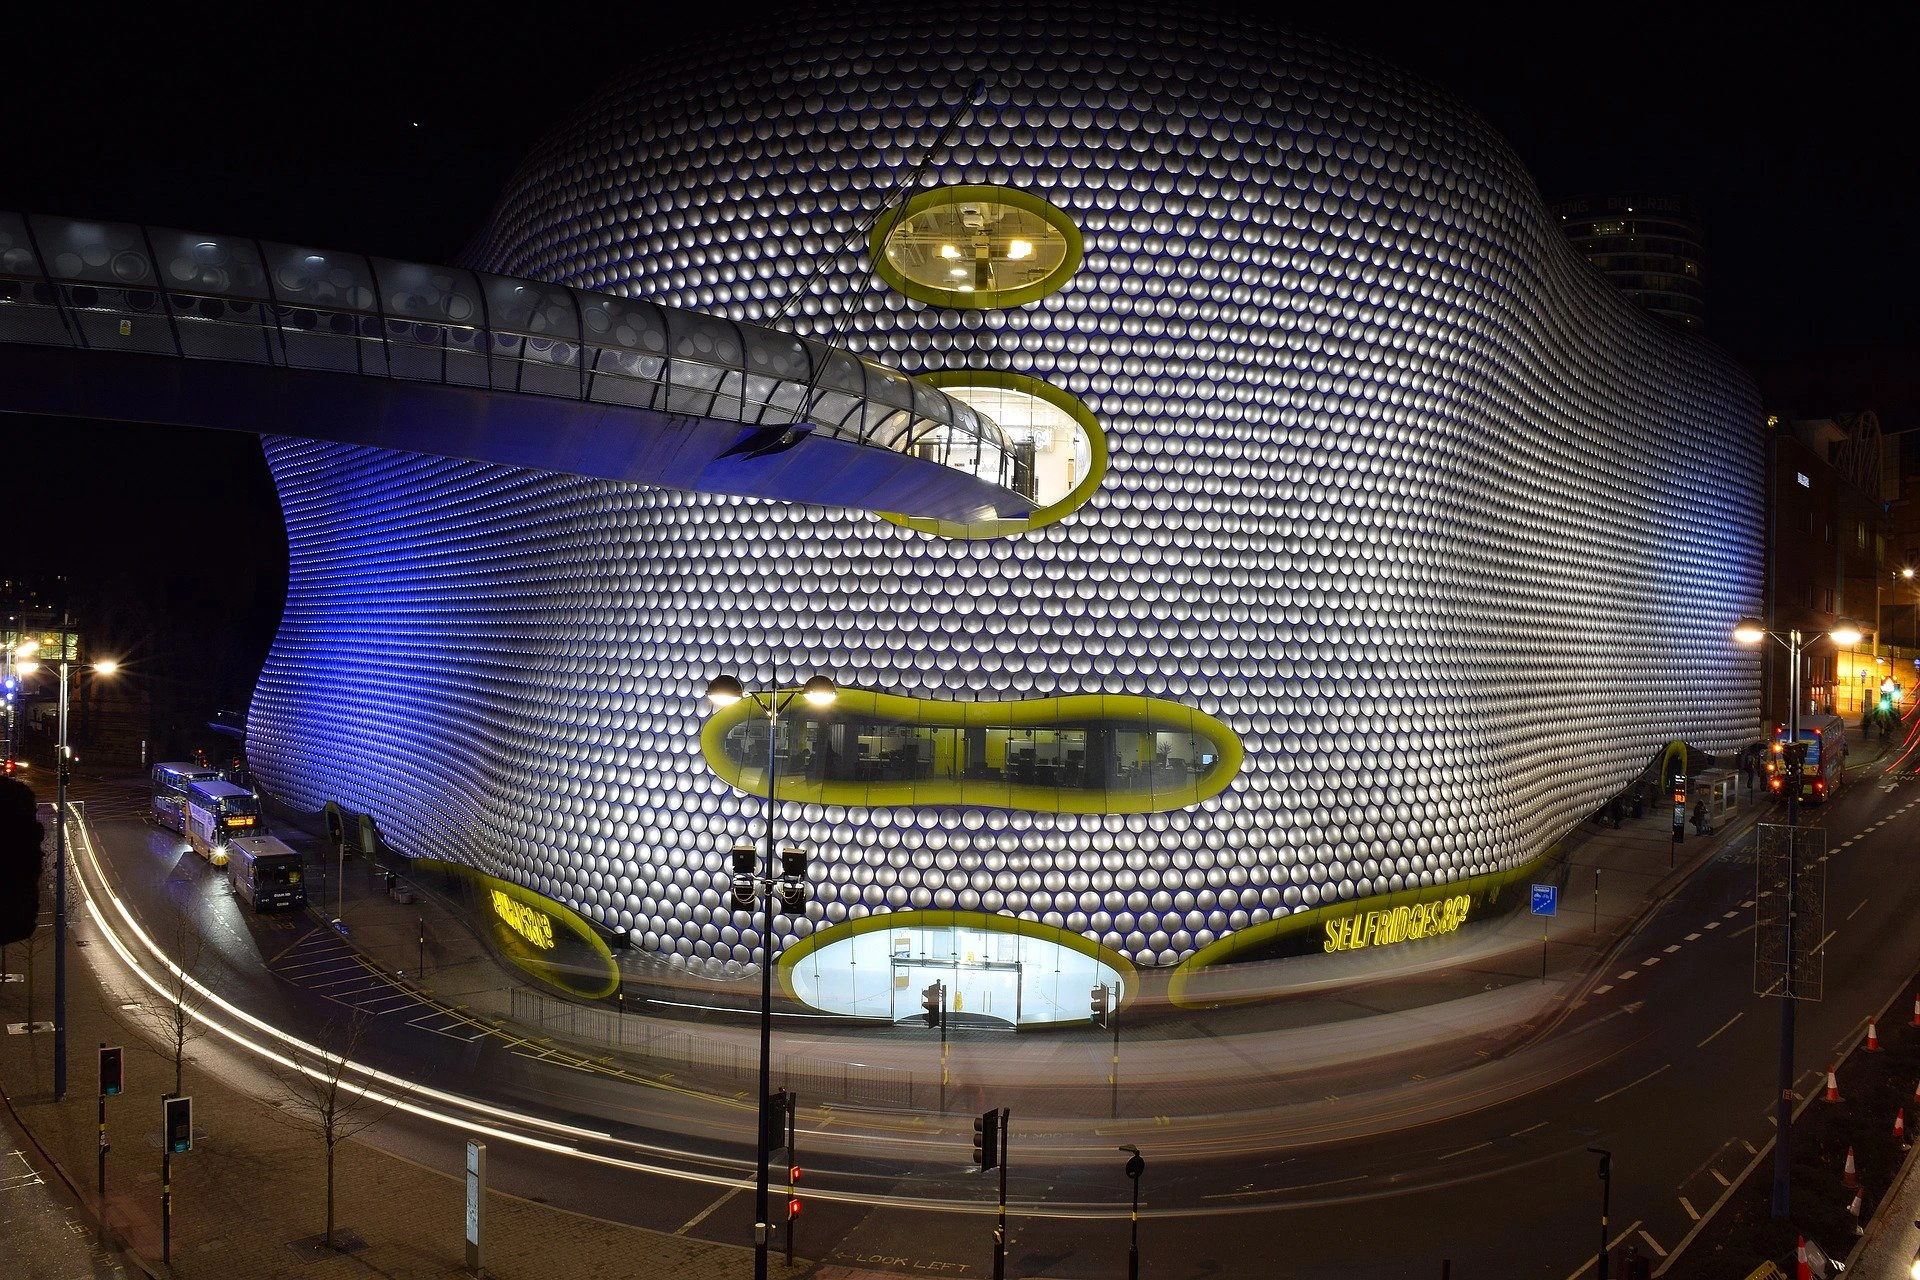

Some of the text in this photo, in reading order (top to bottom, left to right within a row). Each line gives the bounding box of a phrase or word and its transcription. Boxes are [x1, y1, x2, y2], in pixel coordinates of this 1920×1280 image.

[1607, 195, 1681, 212] BULLRING
[855, 1253, 972, 1273] LOOK LEFT
